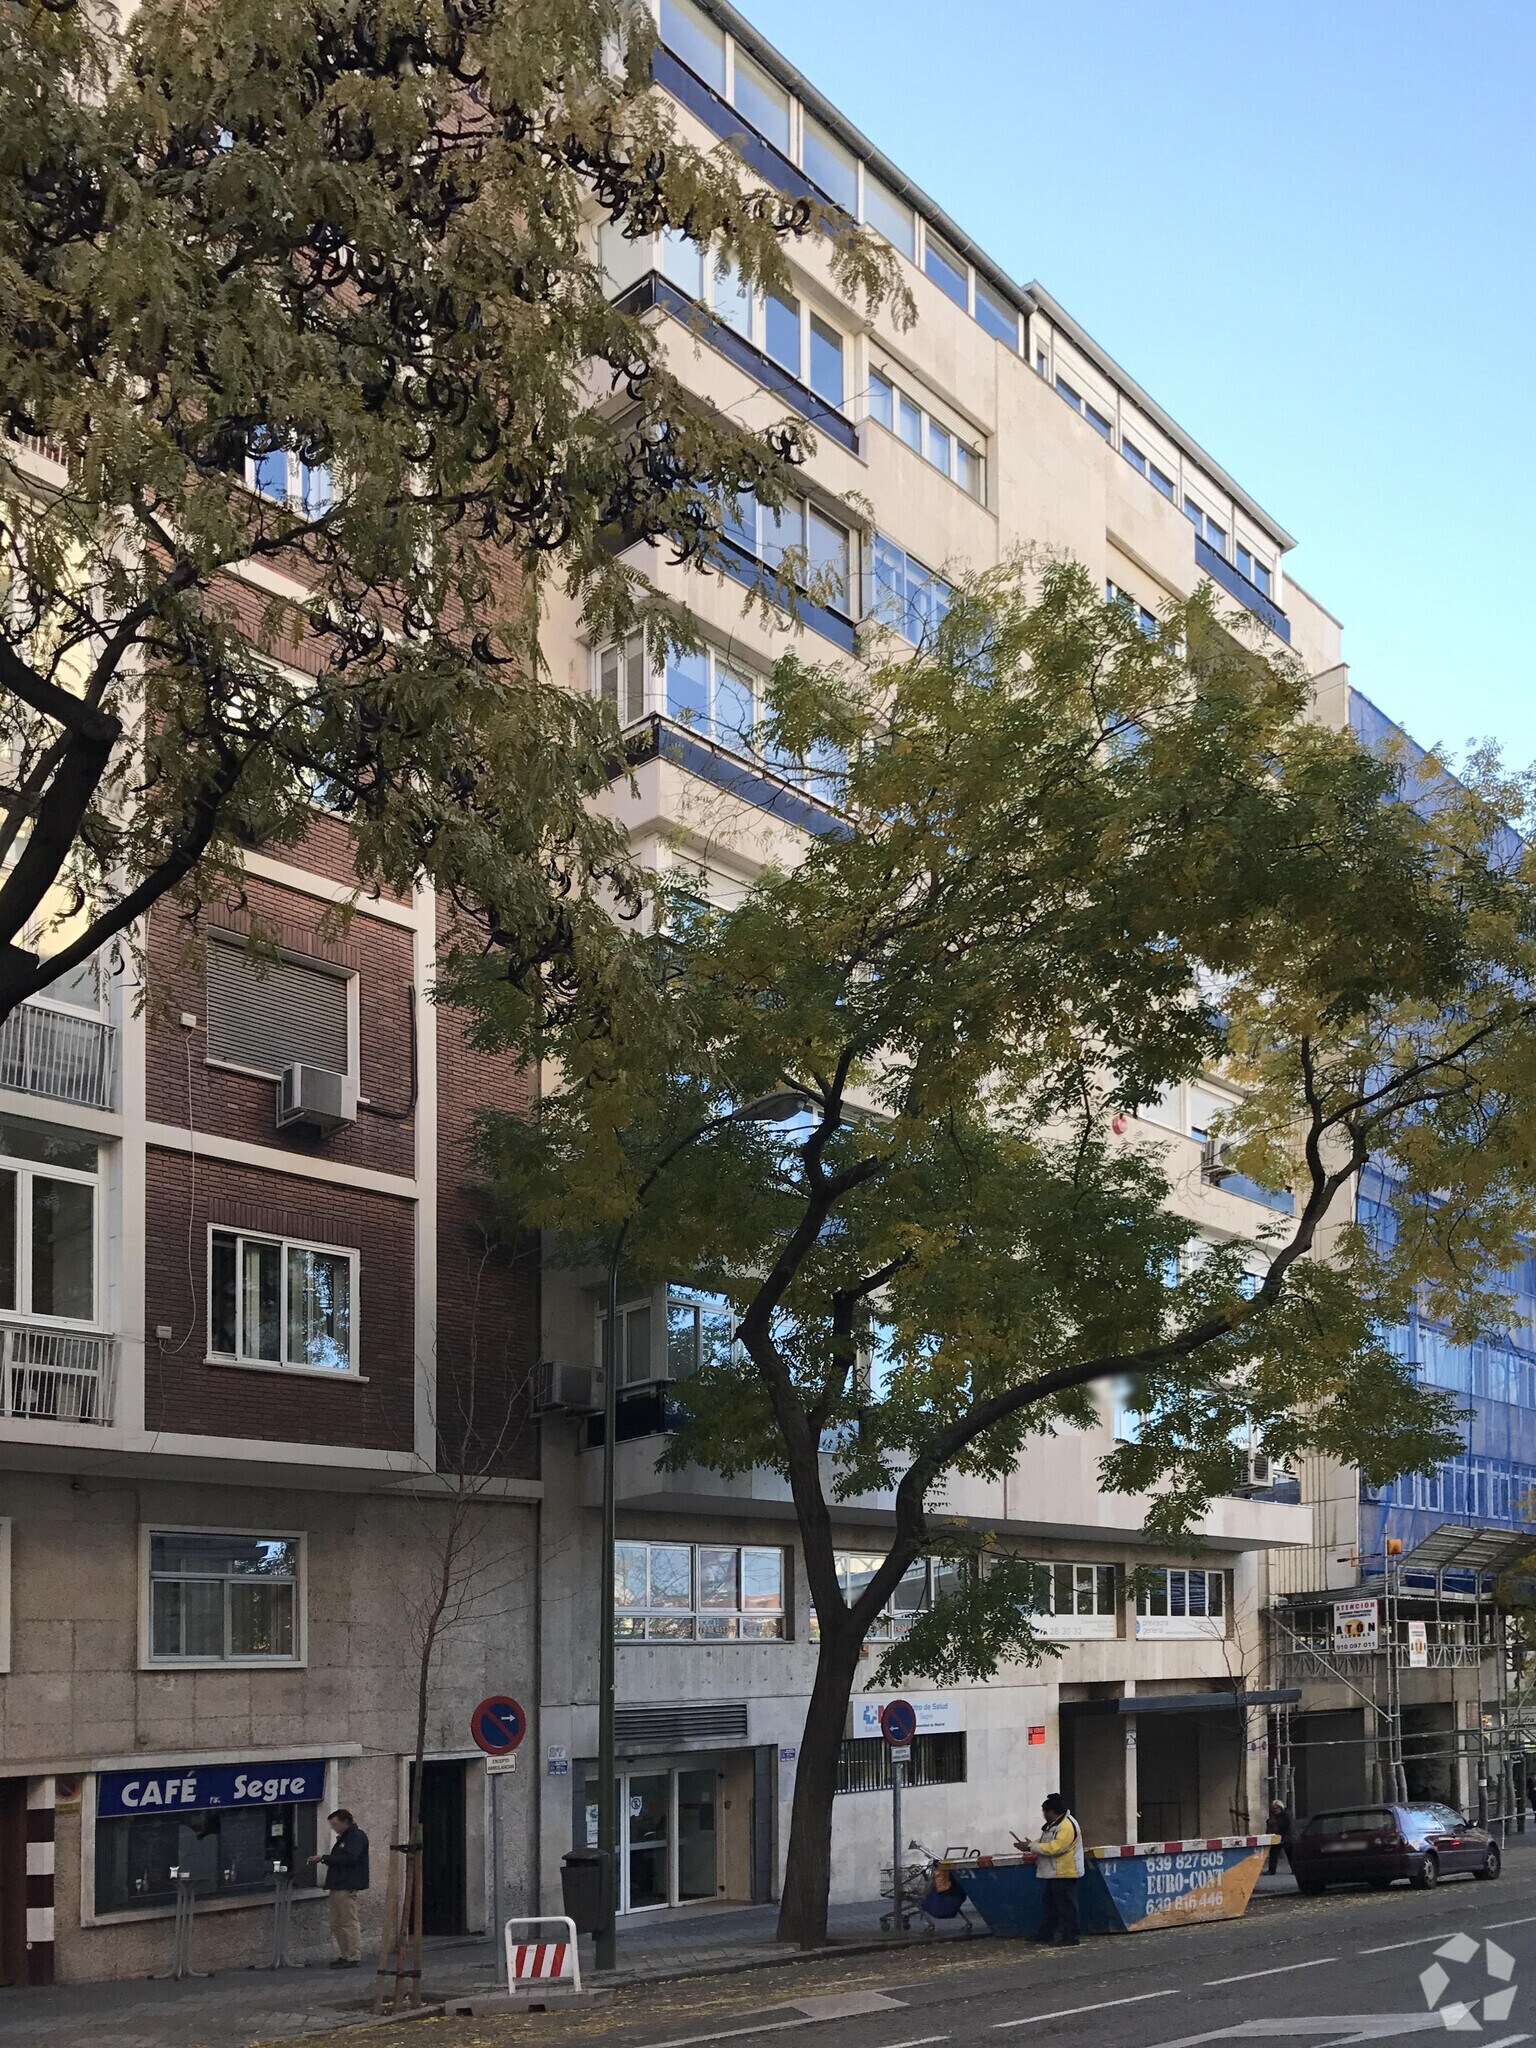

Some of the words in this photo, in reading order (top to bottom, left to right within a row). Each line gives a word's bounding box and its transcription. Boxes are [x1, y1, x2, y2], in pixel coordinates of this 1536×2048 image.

[121, 1770, 198, 1808] CAFÉ
[233, 1774, 306, 1802] Segre
[1175, 1853, 1199, 1870] 827
[1201, 1851, 1224, 1867] 605
[1147, 1868, 1224, 1895] EURO-CONT
